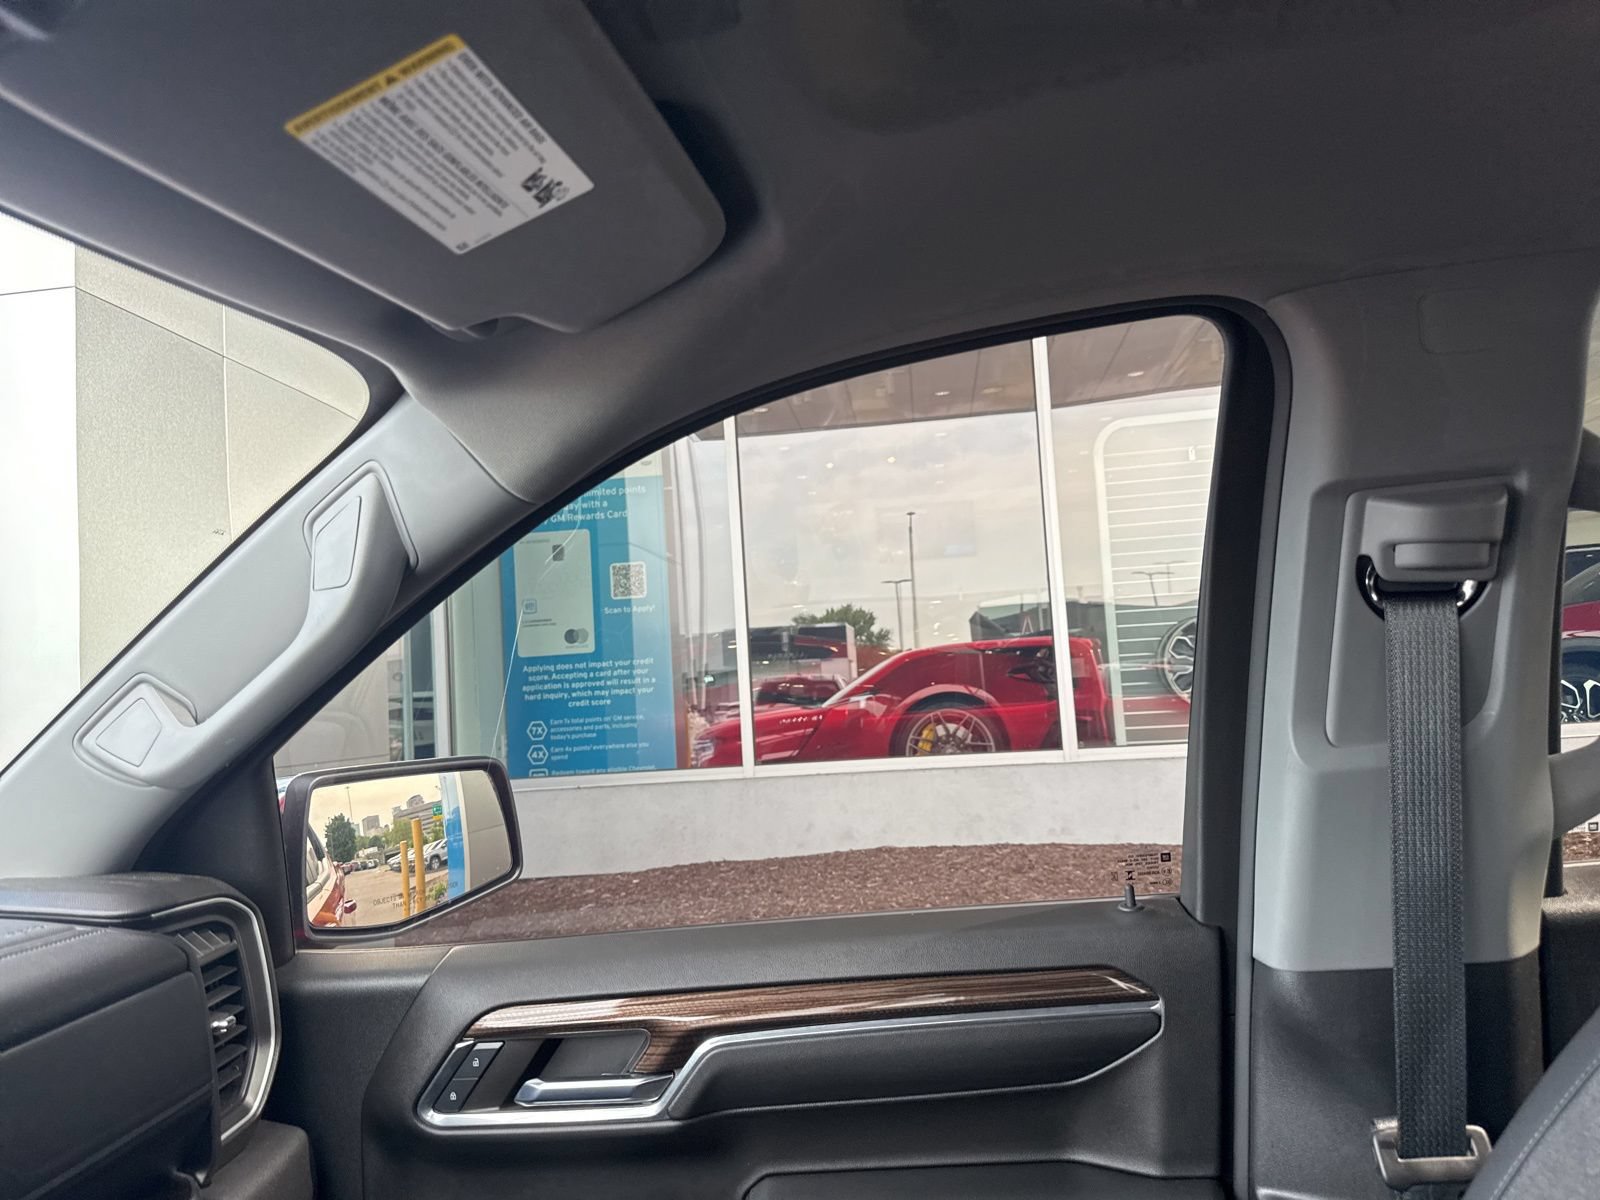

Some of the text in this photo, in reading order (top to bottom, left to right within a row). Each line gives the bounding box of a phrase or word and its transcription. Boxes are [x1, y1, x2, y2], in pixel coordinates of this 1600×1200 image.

[618, 485, 647, 496] points
[582, 500, 600, 508] with
[568, 512, 605, 521] Rewards
[604, 606, 622, 615] Scan
[523, 665, 554, 673] Applying
[552, 672, 588, 680] Accepting
[522, 684, 561, 692] application
[571, 680, 605, 689] approved
[543, 691, 570, 700] inquiry,
[611, 687, 635, 695] impact
[568, 699, 589, 707] credit
[531, 726, 543, 735] 7X
